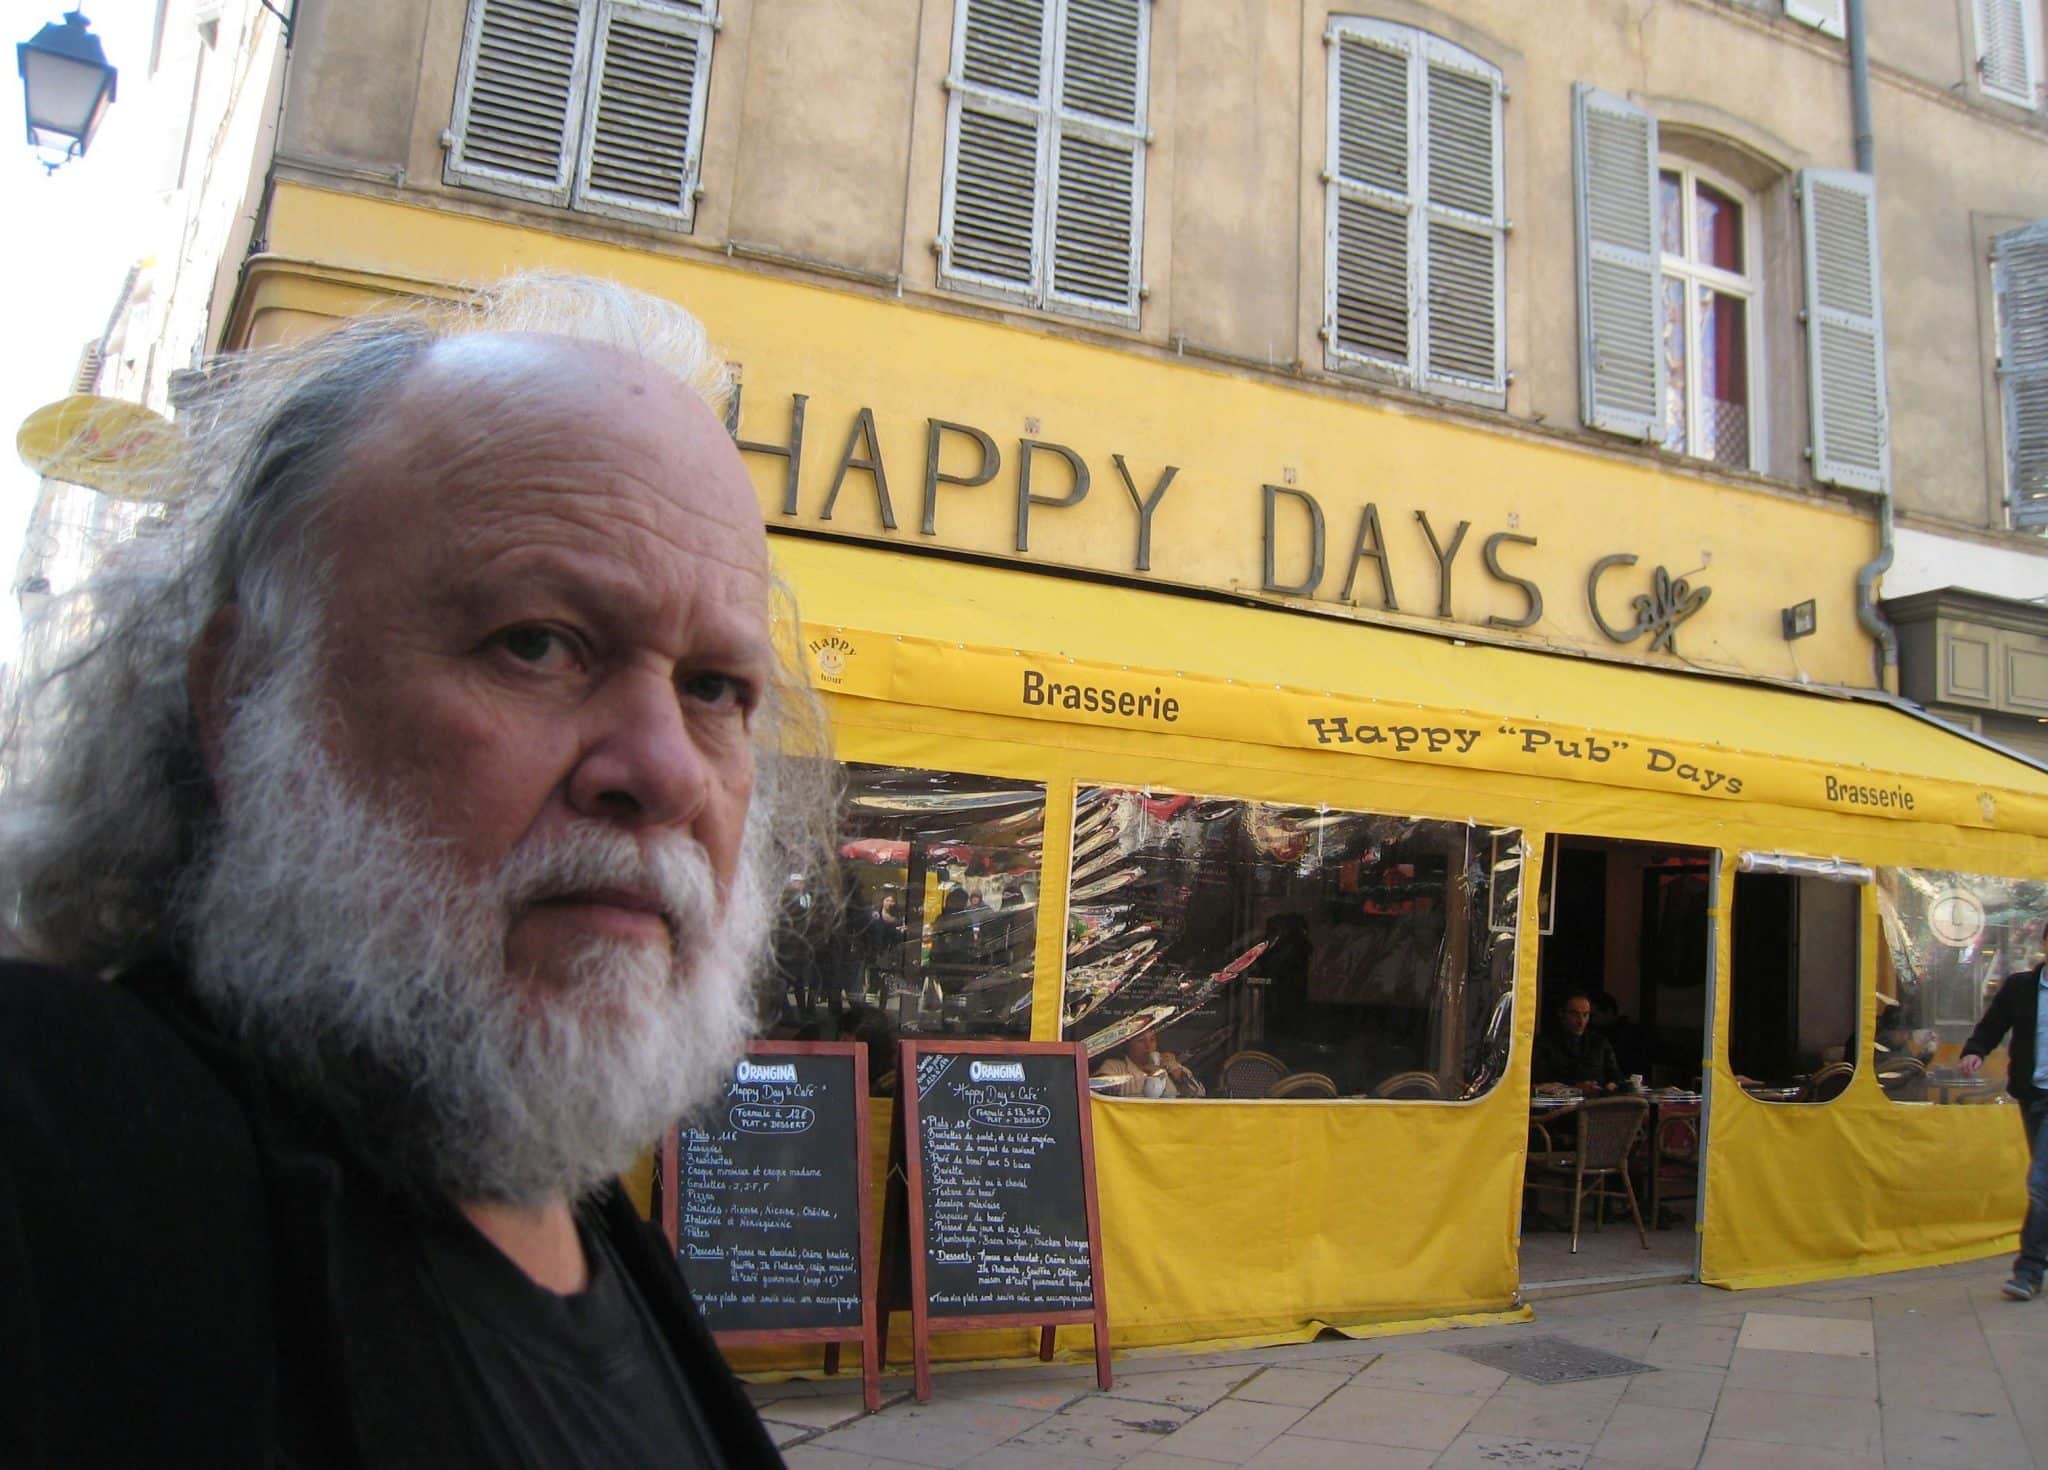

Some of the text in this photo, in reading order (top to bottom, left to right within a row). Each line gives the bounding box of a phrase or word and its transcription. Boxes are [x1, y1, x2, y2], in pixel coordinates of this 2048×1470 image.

[727, 383, 1543, 629] HAPPY DAYS
[808, 637, 857, 656] Happy
[1023, 670, 1180, 722] Brasserie
[1307, 717, 1481, 753] Happy
[1646, 748, 1744, 794] Days
[1825, 775, 1915, 811] Brasserie
